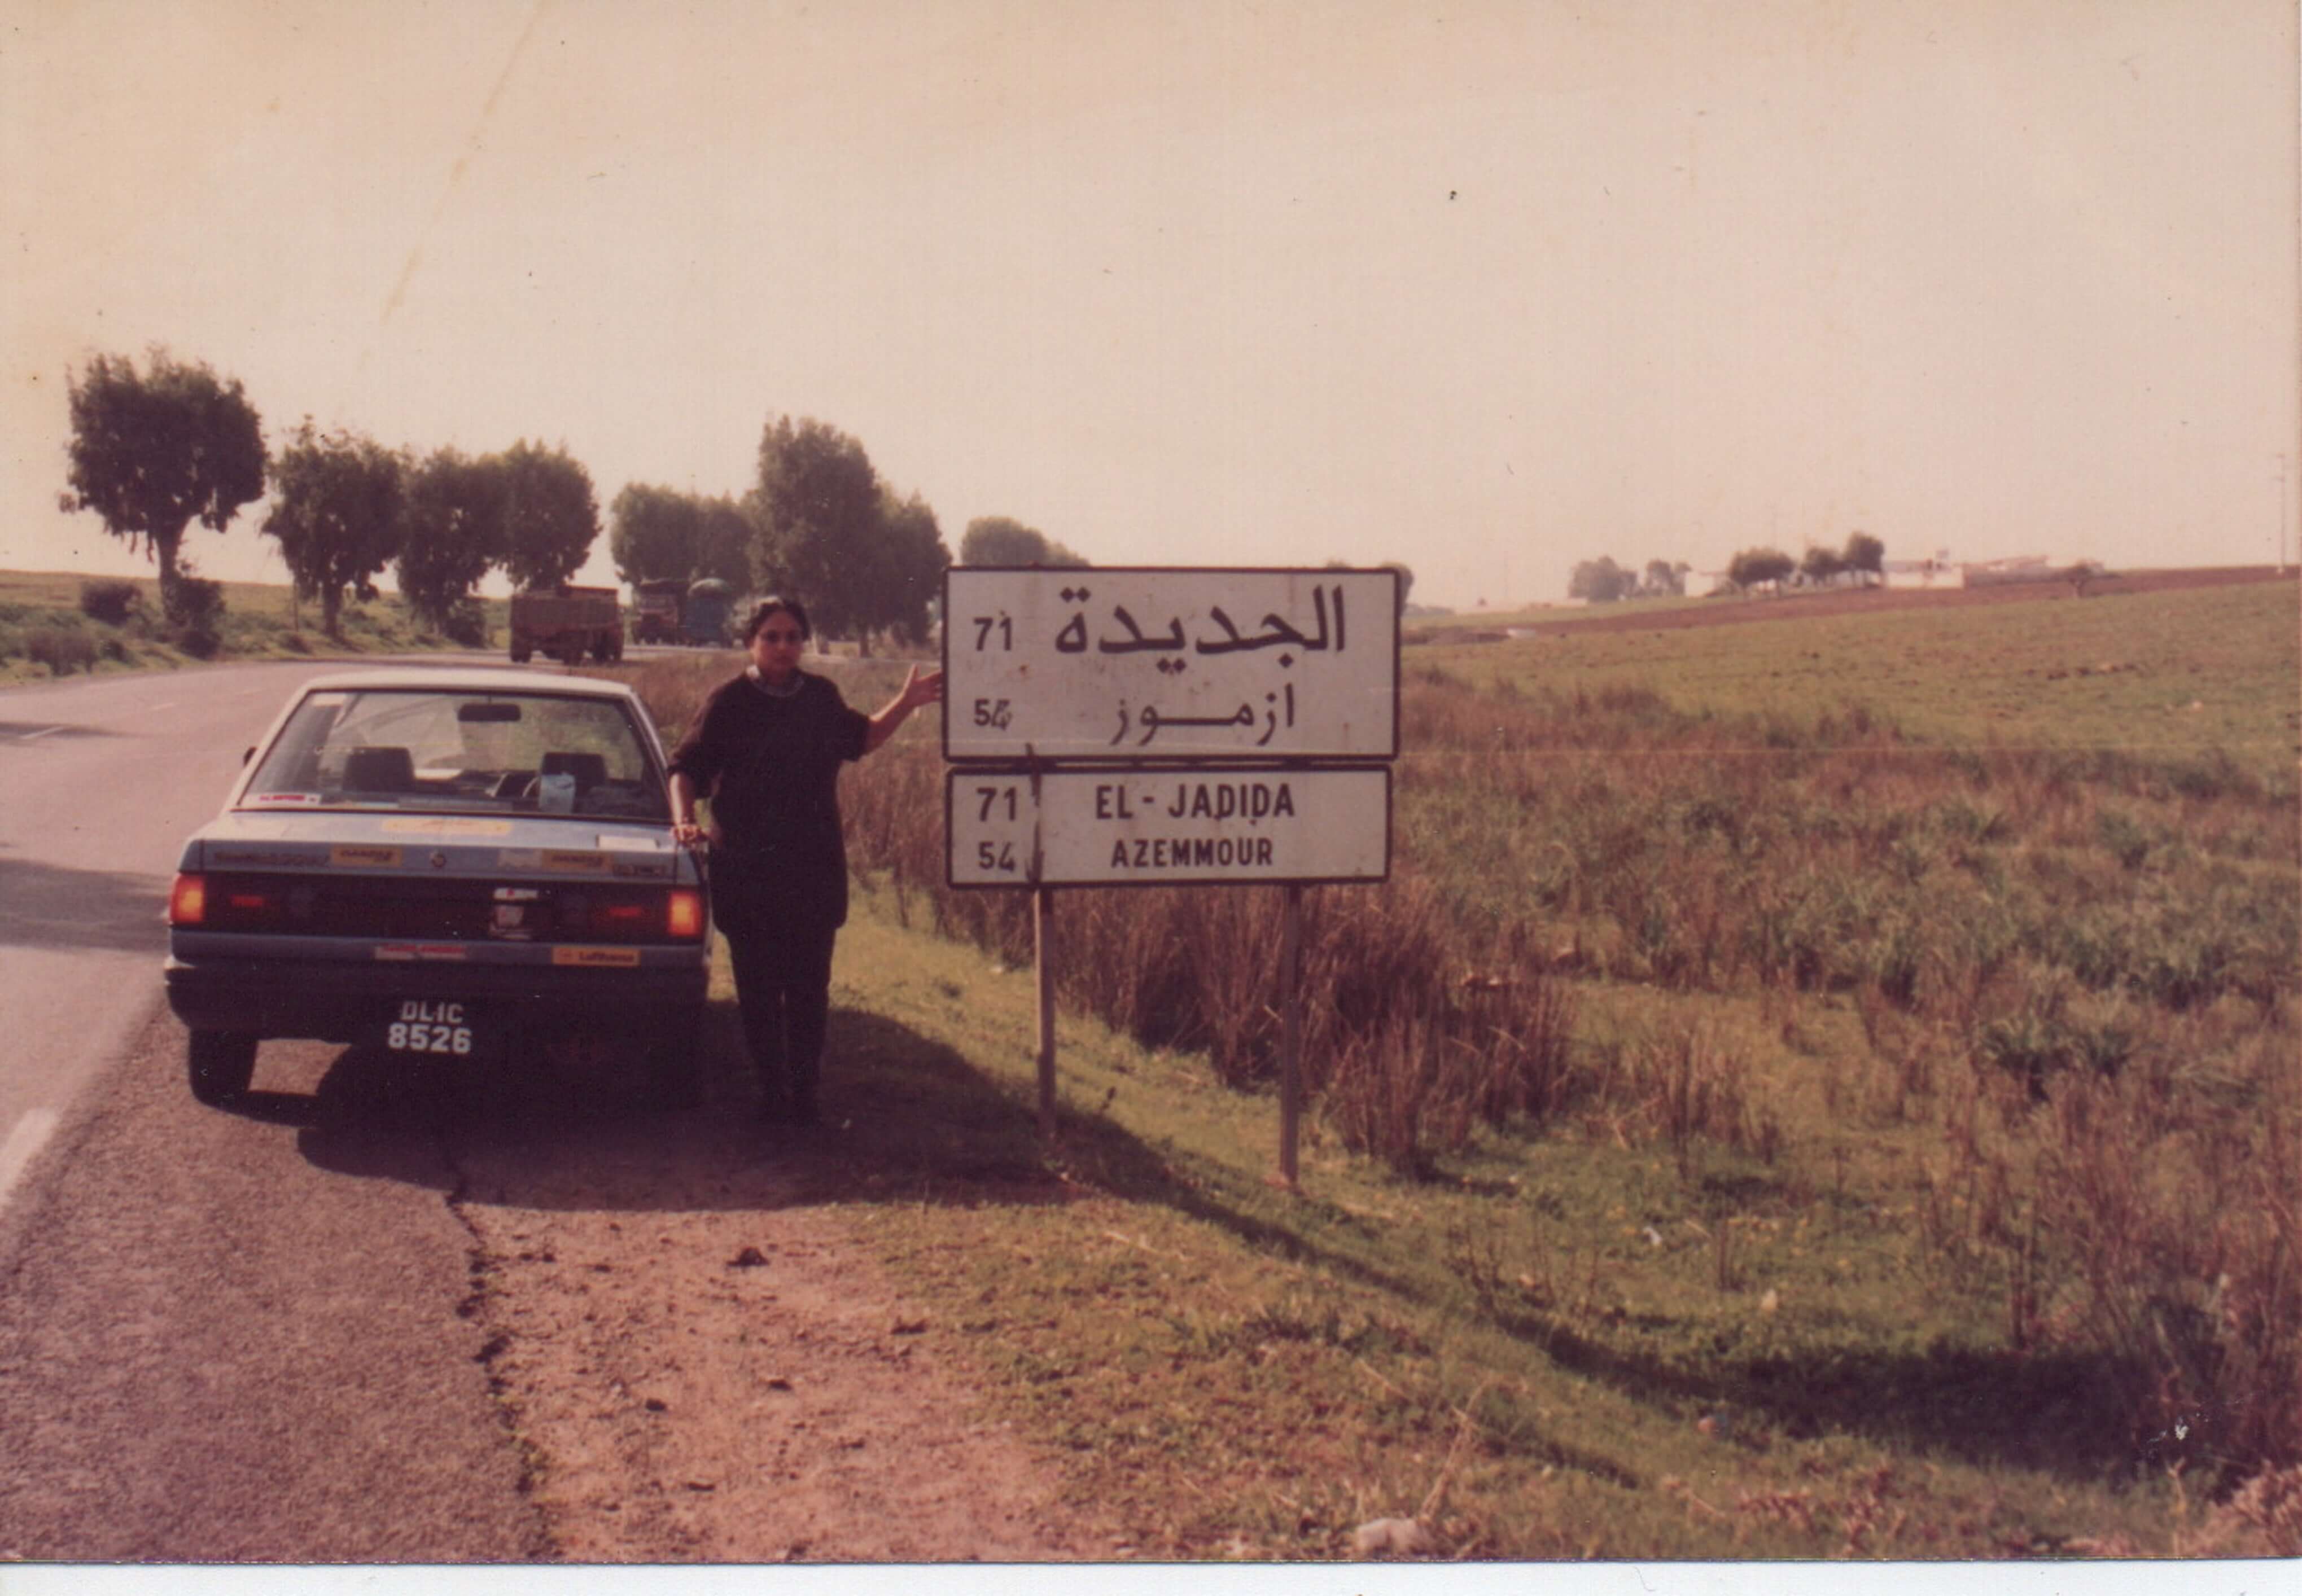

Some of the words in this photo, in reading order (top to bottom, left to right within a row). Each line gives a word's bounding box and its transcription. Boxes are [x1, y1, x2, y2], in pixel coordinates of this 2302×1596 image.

[973, 616, 1012, 651] 71
[1056, 585, 1345, 673] الجديدة
[977, 787, 1016, 822] 71
[978, 841, 1016, 872] 54
[1111, 838, 1273, 868] AZEMMOUR
[388, 1022, 472, 1054] 8526
